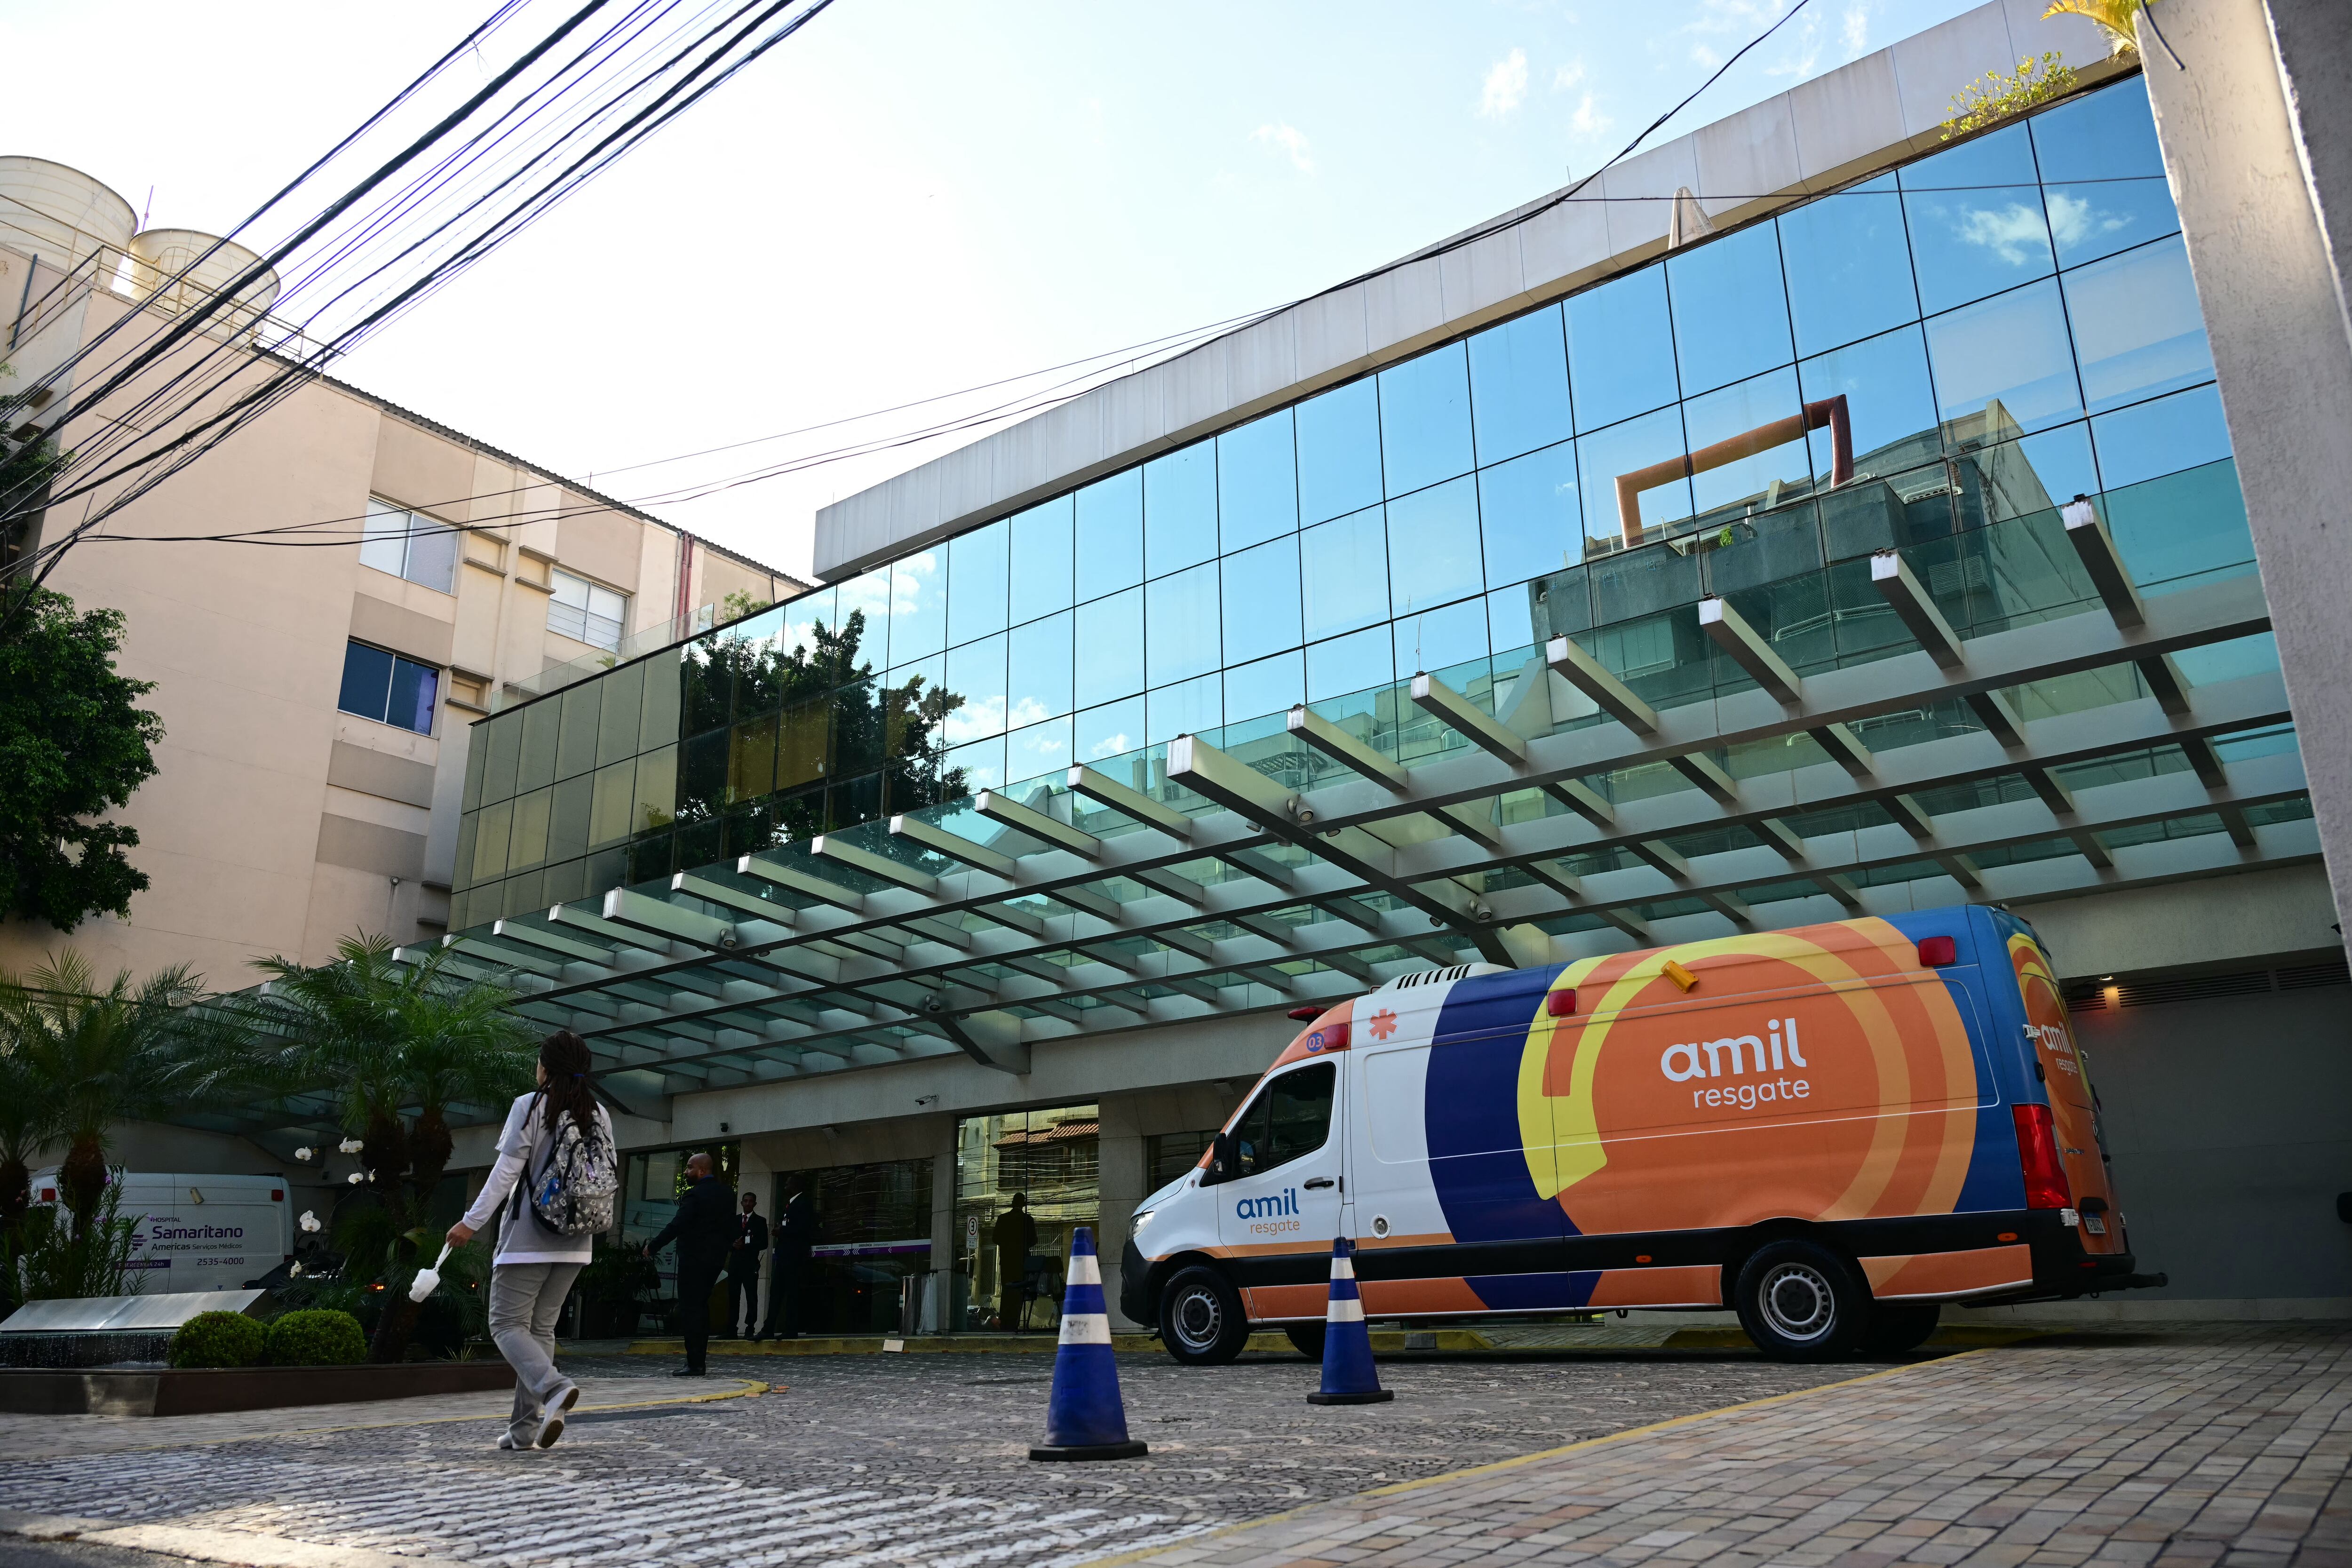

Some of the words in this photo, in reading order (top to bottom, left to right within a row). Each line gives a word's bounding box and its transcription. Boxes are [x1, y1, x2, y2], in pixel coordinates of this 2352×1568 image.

[1308, 1036, 1322, 1048] 03
[2041, 1021, 2073, 1055] amil
[1661, 1018, 1806, 1082] amil
[2056, 1058, 2078, 1076] resgate
[1693, 1077, 1810, 1110] resgate
[1237, 1188, 1299, 1219] amil
[152, 1225, 243, 1239] Samaritano
[1250, 1219, 1300, 1235] resgate
[197, 1257, 244, 1266] 2535-4000
